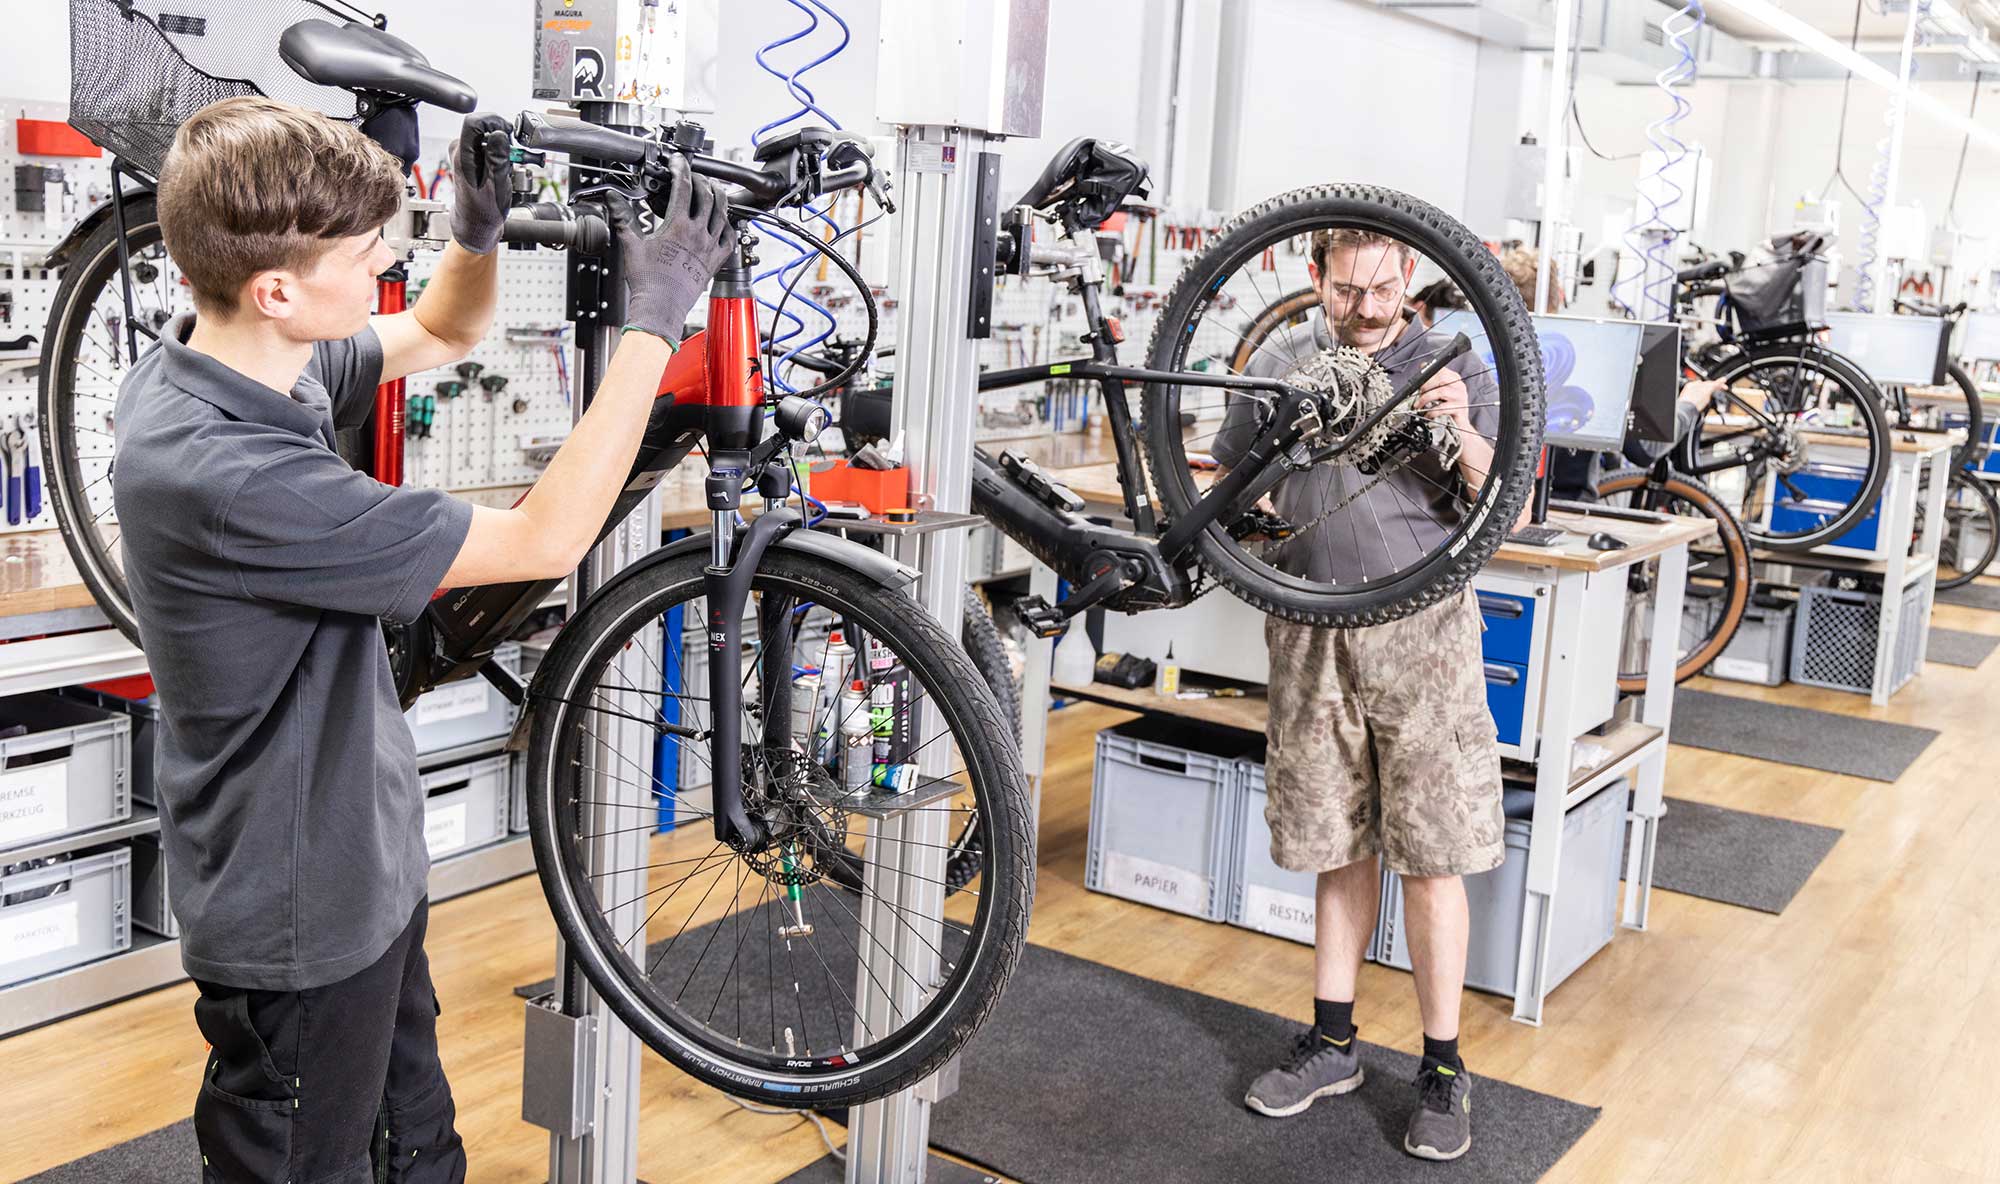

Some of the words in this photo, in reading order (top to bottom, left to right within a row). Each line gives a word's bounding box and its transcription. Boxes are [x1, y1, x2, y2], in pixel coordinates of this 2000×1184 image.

[710, 631, 726, 642] NEX
[0, 784, 37, 803] REMSE
[1134, 873, 1178, 895] PAPIER
[1269, 903, 1315, 925] RESTM
[681, 1051, 707, 1068] PLUS
[787, 1060, 813, 1068] RYDE
[709, 1066, 763, 1088] MARATHON
[803, 1075, 861, 1093] SCHWALBE
